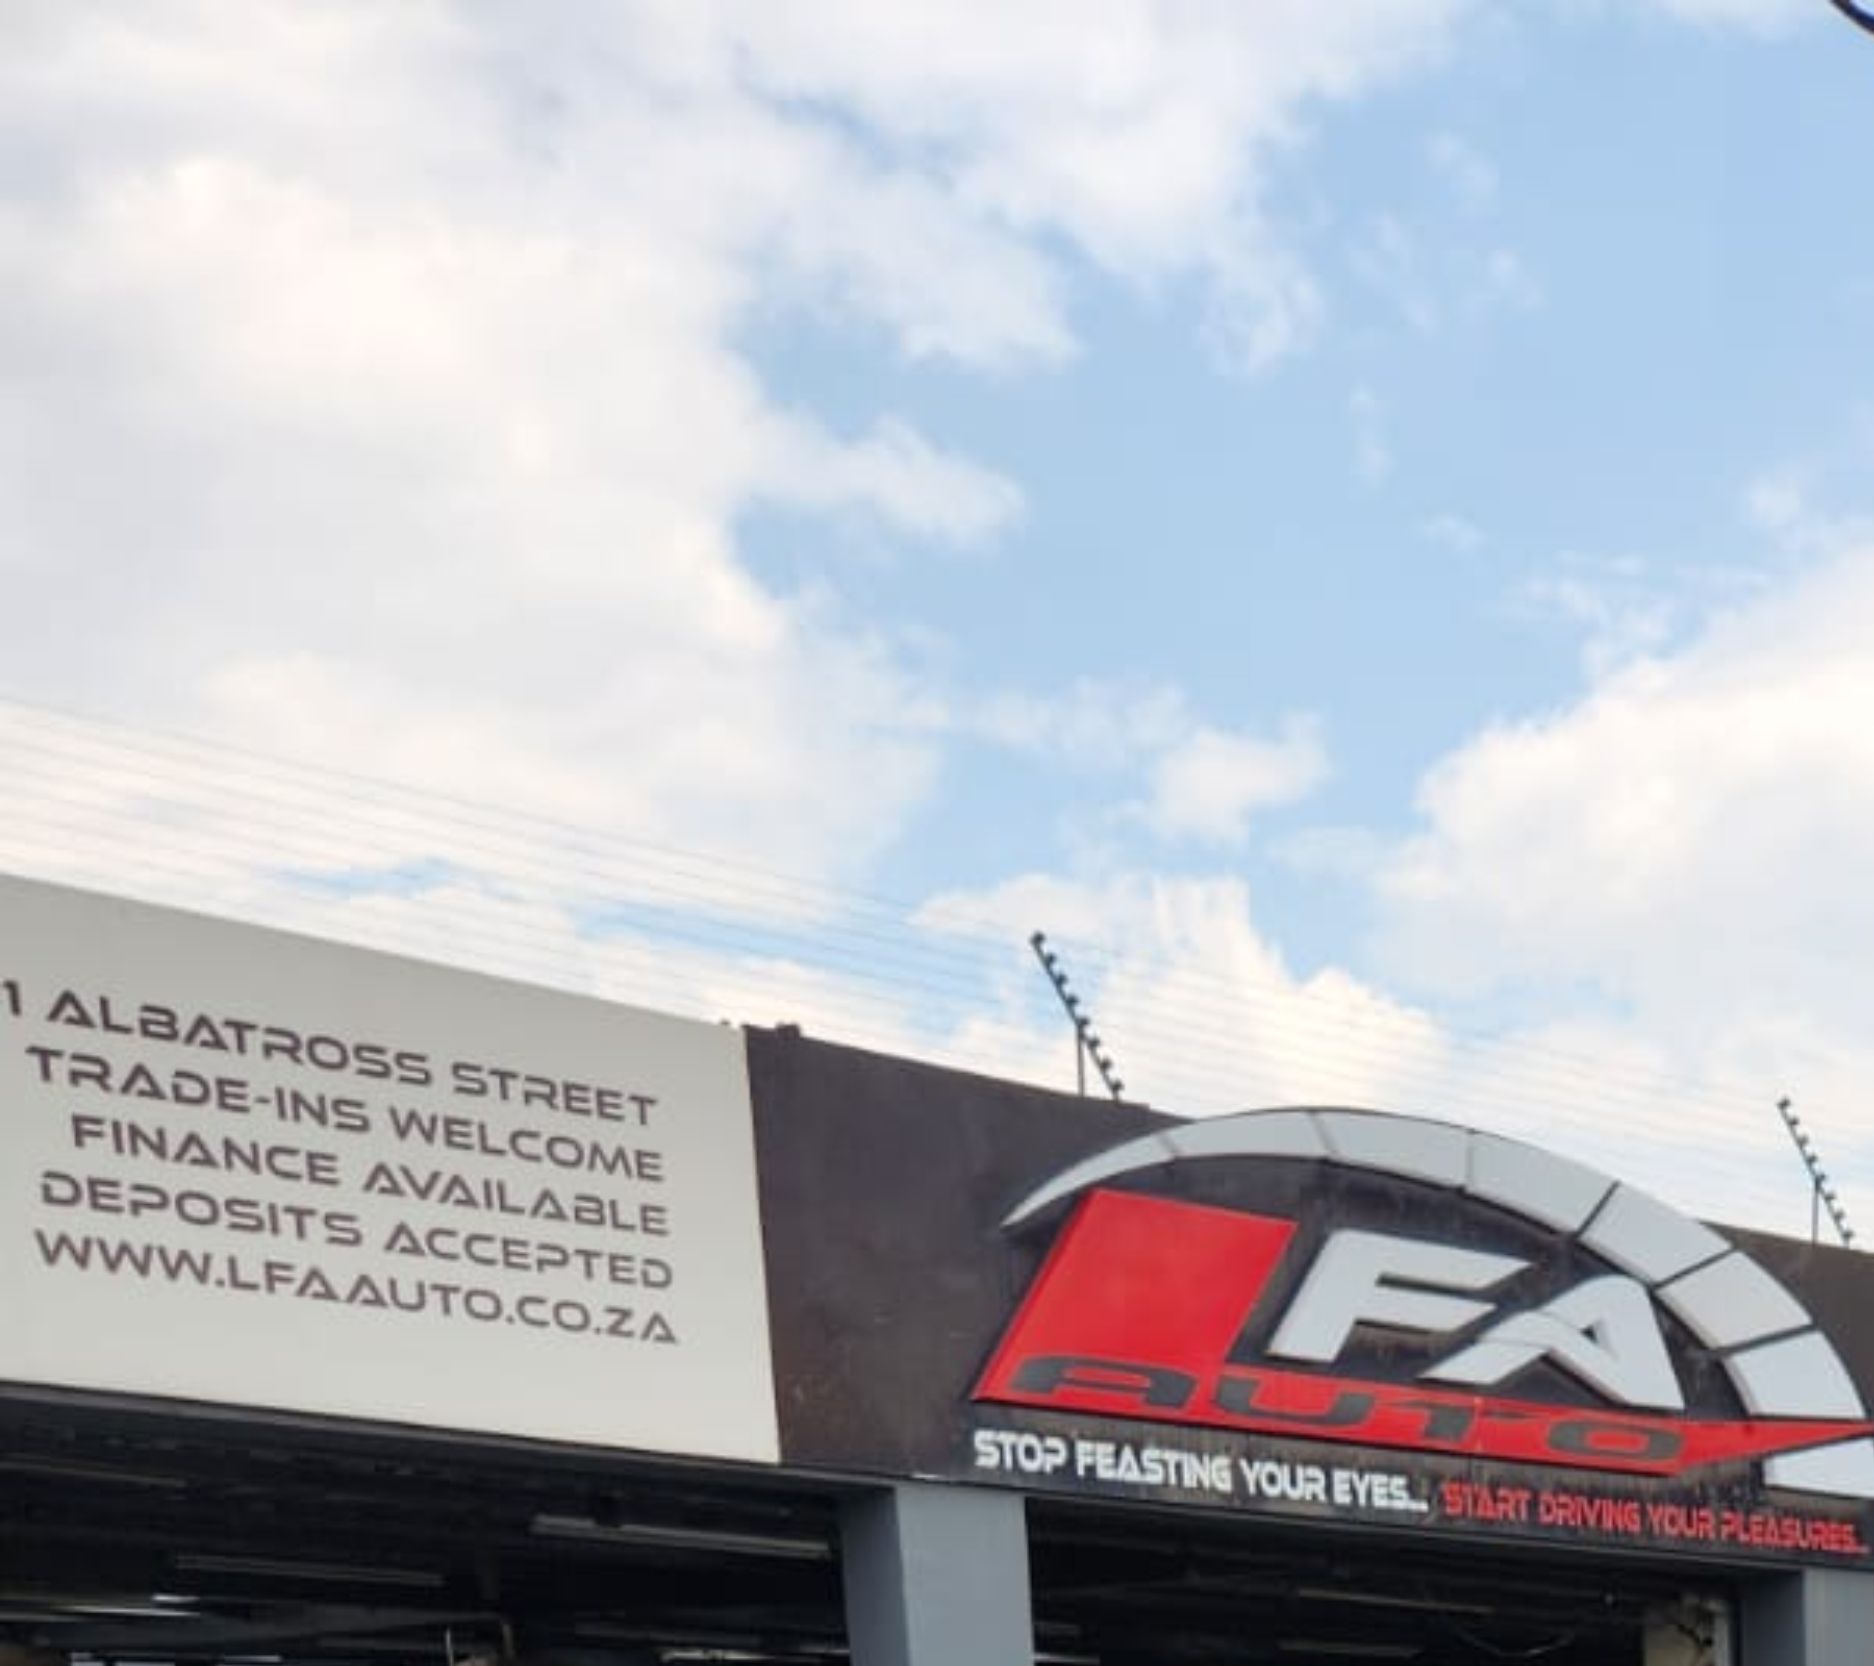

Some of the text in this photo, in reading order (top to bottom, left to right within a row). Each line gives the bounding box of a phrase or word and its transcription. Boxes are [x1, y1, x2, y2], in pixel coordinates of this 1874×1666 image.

[2, 979, 656, 1126] 1 ALBATROSS STREET
[25, 1045, 664, 1183] TRADE-INS WELCOME
[41, 1171, 674, 1290] DEPOSITS ACCEPTED
[71, 1112, 671, 1237] FINANCE AVAILABLE
[34, 1228, 678, 1345] WWW.LFAAUTO.CO.ZA
[1008, 1355, 1687, 1463] AUTO
[973, 1428, 1069, 1475] STOP
[1075, 1440, 1233, 1492] FEASTING
[1239, 1457, 1327, 1501] YOUR
[1440, 1479, 1532, 1521] START
[1538, 1489, 1641, 1538] DRIVING
[1646, 1504, 1717, 1542] YOUR
